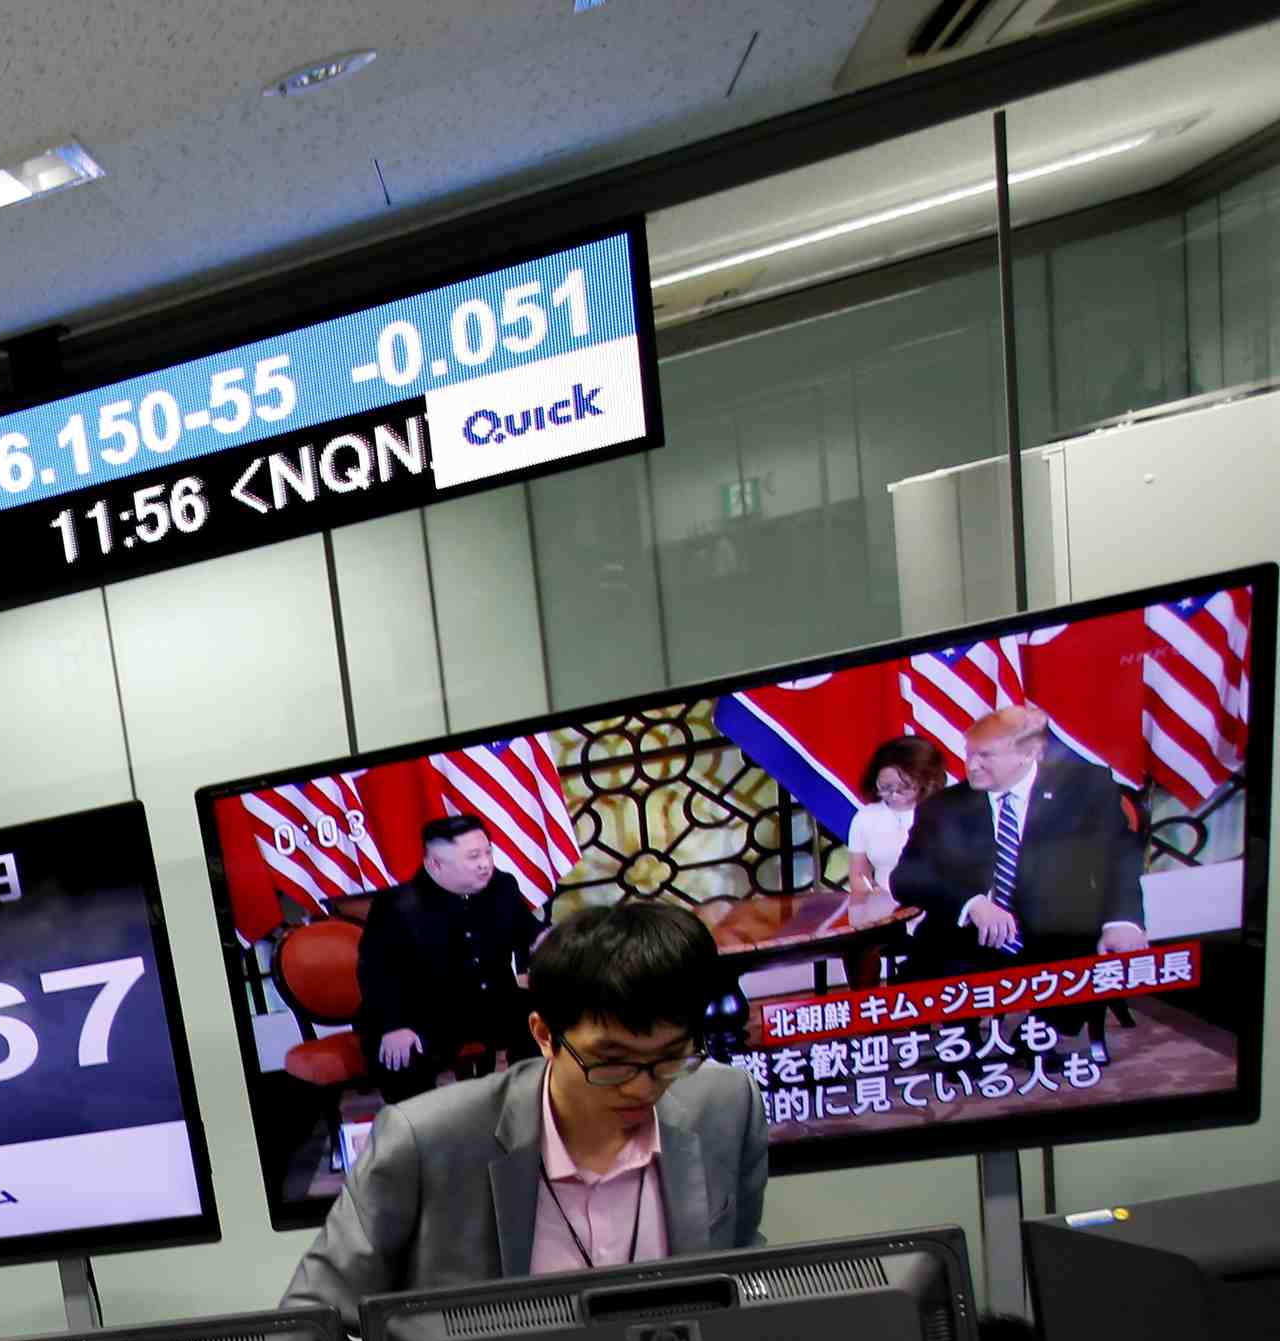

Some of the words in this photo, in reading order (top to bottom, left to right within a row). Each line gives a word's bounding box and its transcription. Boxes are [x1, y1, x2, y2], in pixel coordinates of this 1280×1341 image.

[350, 268, 590, 388] -0.051
[49, 476, 207, 563] 11:56
[230, 411, 433, 513] <NQN
[274, 809, 365, 856] 0:03
[769, 1001, 851, 1038] 北朝鮮
[859, 950, 1193, 1022] キム・ジョンウン委員長
